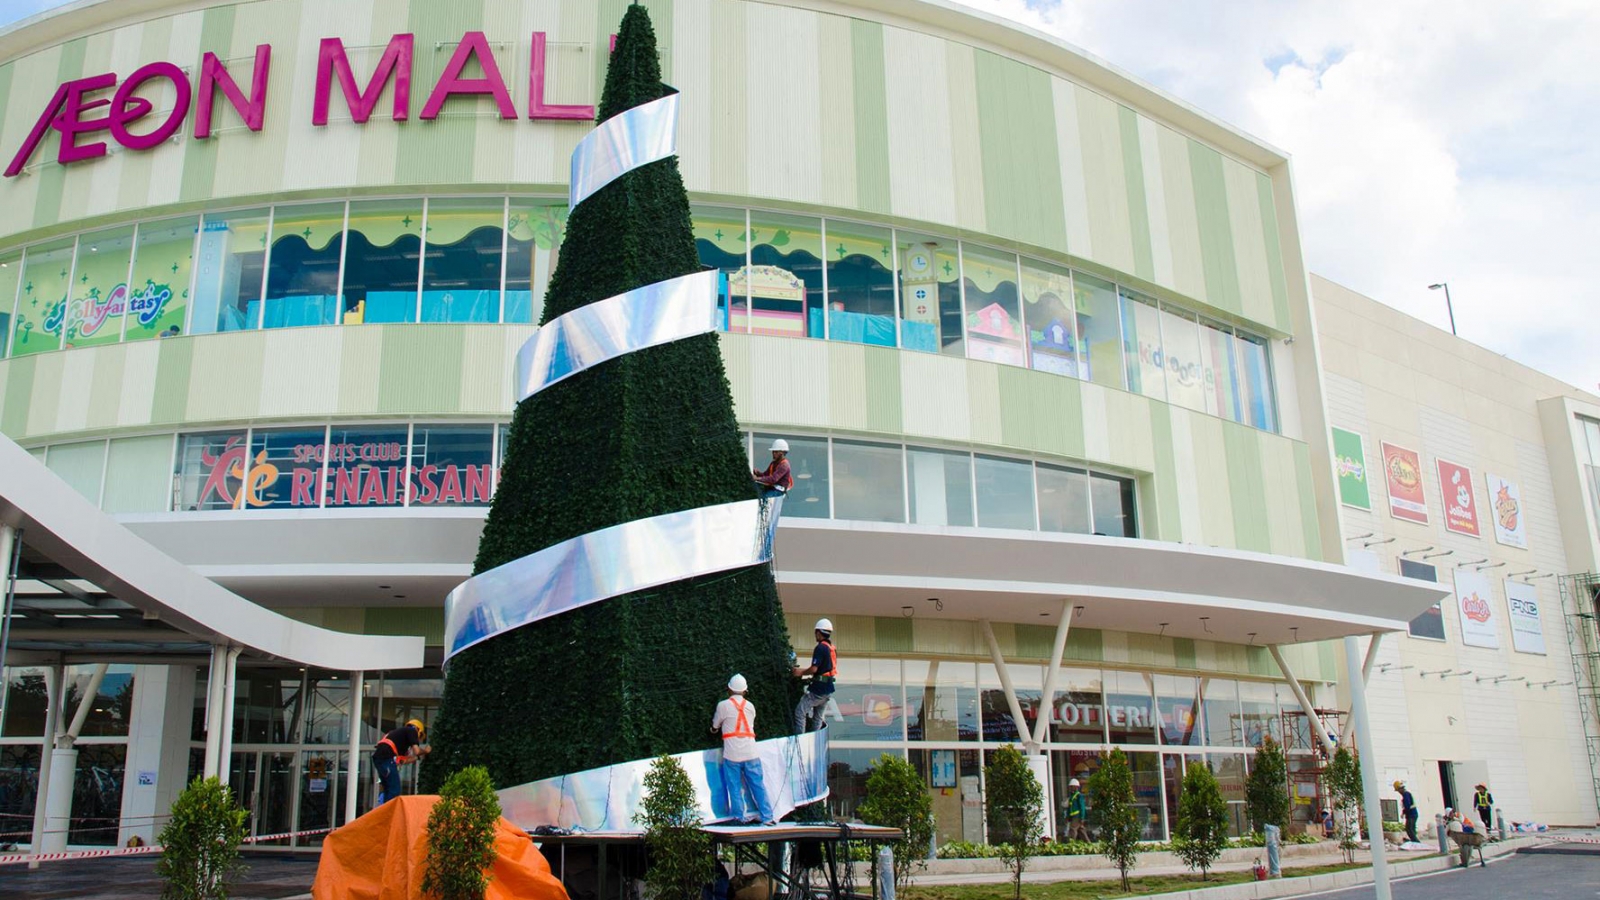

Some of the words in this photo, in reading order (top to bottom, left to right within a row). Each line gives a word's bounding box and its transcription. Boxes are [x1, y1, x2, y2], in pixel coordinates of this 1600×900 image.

[312, 31, 617, 126] MAL
[293, 443, 356, 463] SPORTS
[359, 442, 401, 462] CLUB
[291, 464, 500, 506] RENAISSAN
[1050, 702, 1166, 729] LOTTERIA
